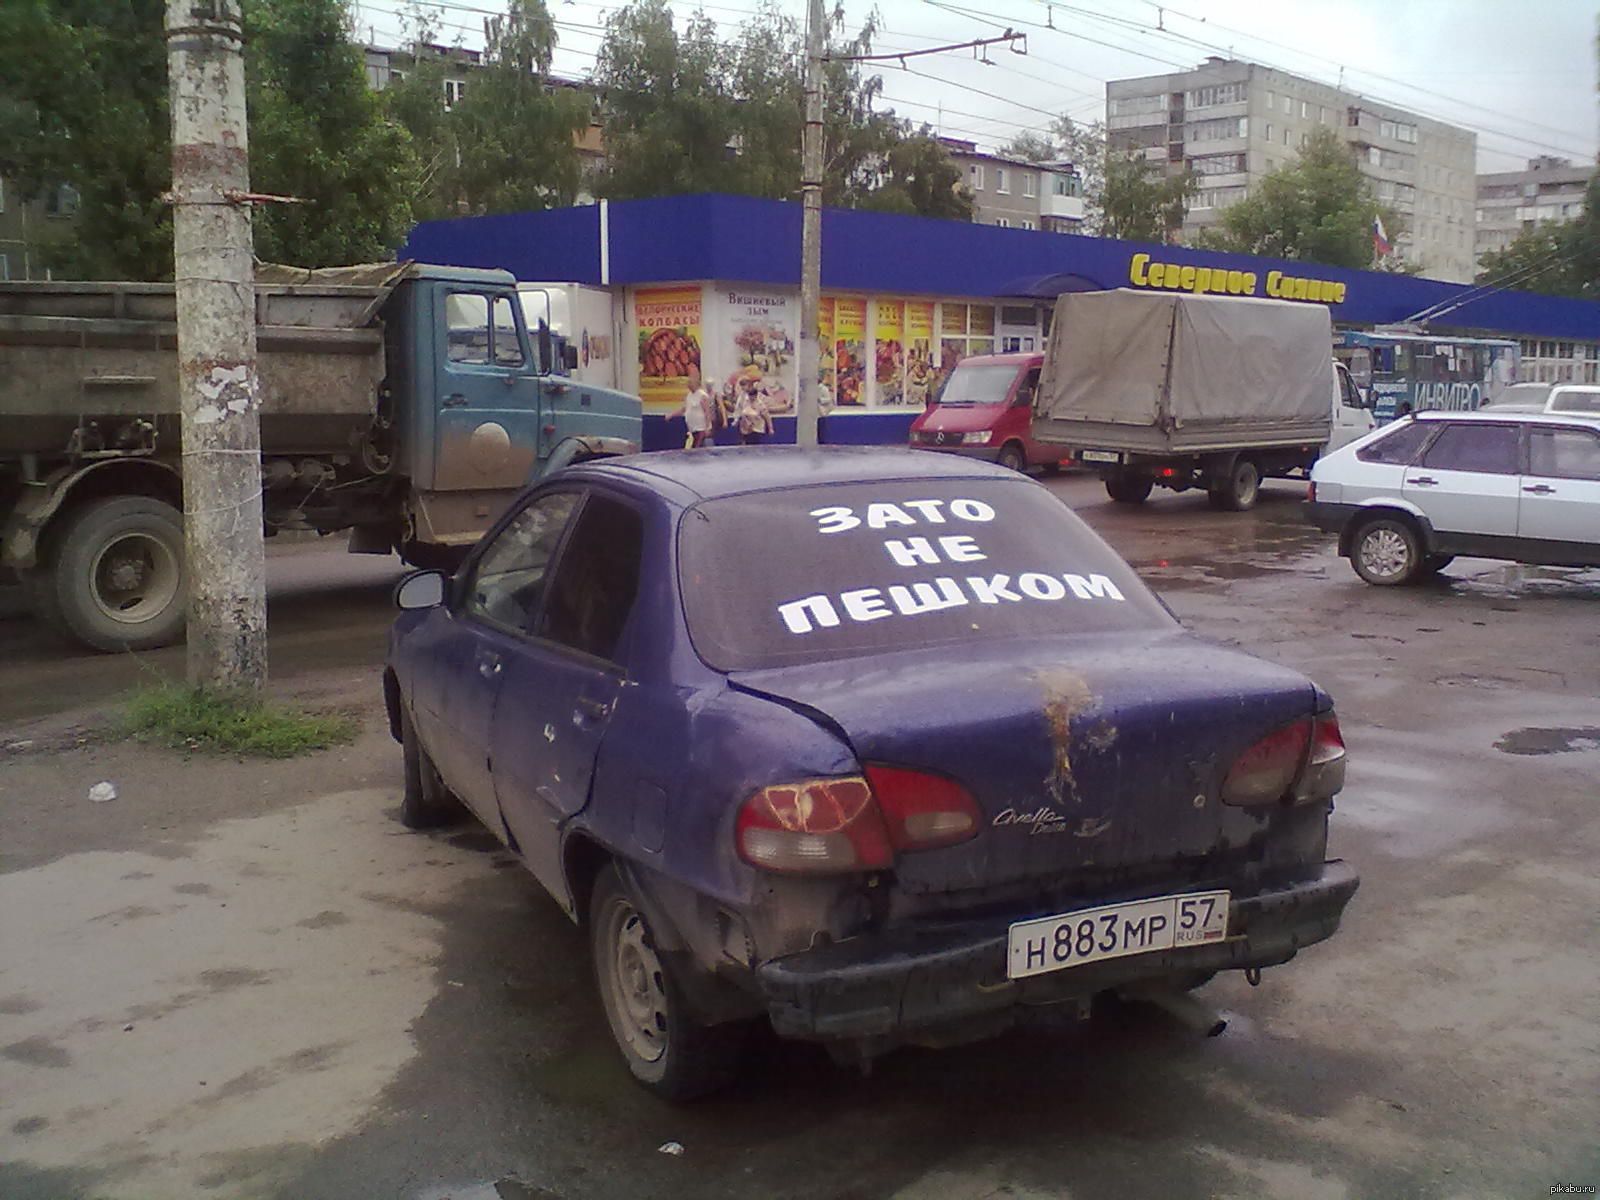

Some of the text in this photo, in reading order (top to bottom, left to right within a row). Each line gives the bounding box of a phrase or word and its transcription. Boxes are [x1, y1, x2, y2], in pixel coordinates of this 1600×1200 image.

[1130, 253, 1256, 294] Северное
[639, 316, 699, 327] КОЛБАСЫ
[1414, 382, 1481, 411] ИНВИТРО
[809, 499, 996, 534] ЗАТО
[884, 535, 988, 567] НЕ
[777, 572, 1126, 634] ПЕШКОМ
[1180, 899, 1216, 929] 57
[1176, 931, 1204, 941] RUS
